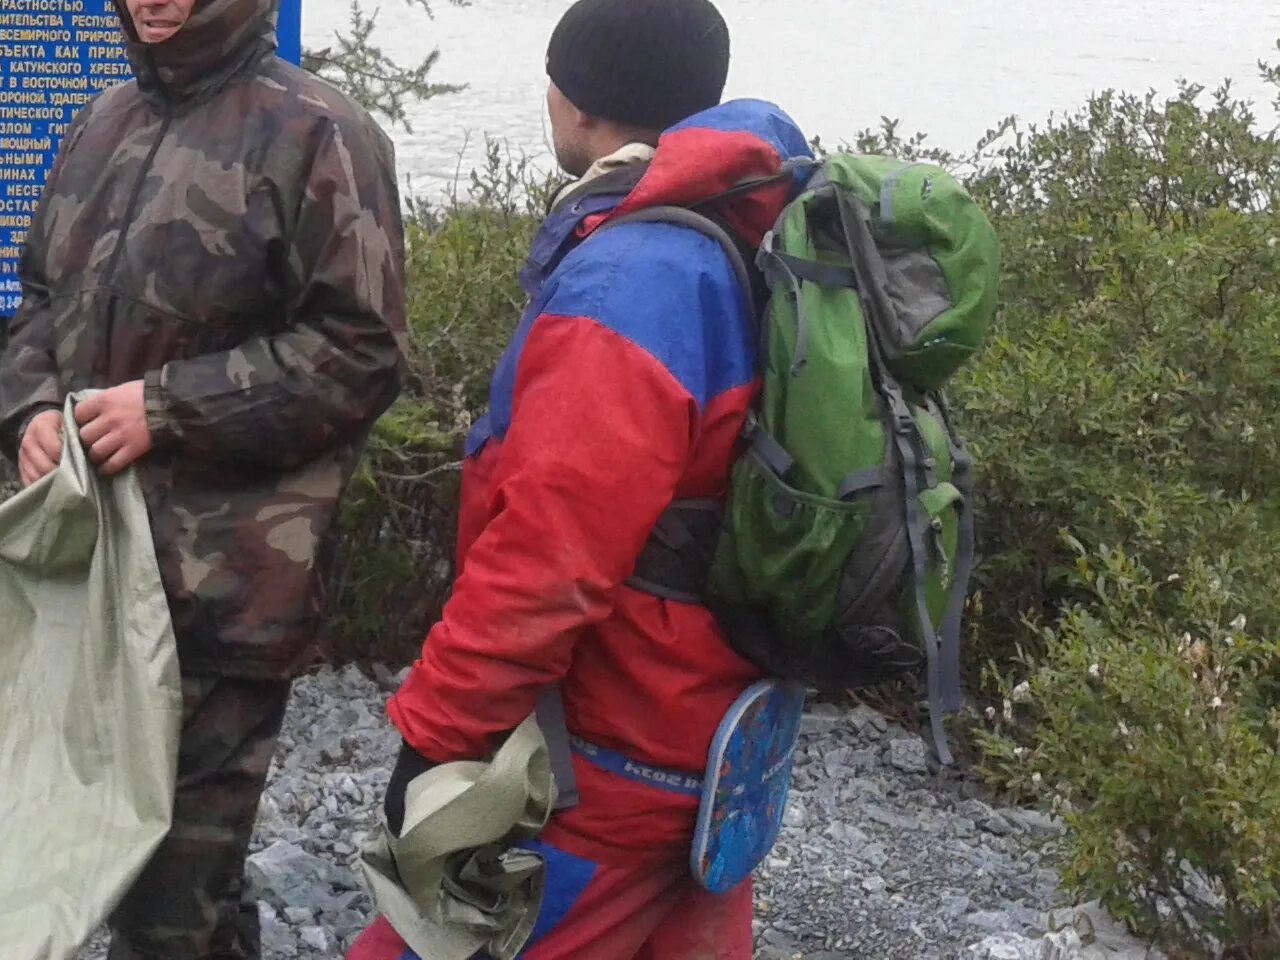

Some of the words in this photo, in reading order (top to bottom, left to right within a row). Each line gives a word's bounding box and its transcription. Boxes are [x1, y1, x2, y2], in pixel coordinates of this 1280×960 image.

[0, 29, 71, 41] ВСЕМИРНОГО
[55, 46, 79, 58] КАК
[10, 61, 81, 74] КАТУНСКОГО
[90, 63, 132, 75] ХРЕБТА
[10, 77, 16, 88] В
[23, 76, 87, 89] ВОСТОЧНОЙ
[0, 137, 51, 151] МОЩНЫЙ
[10, 231, 27, 243] ЗД
